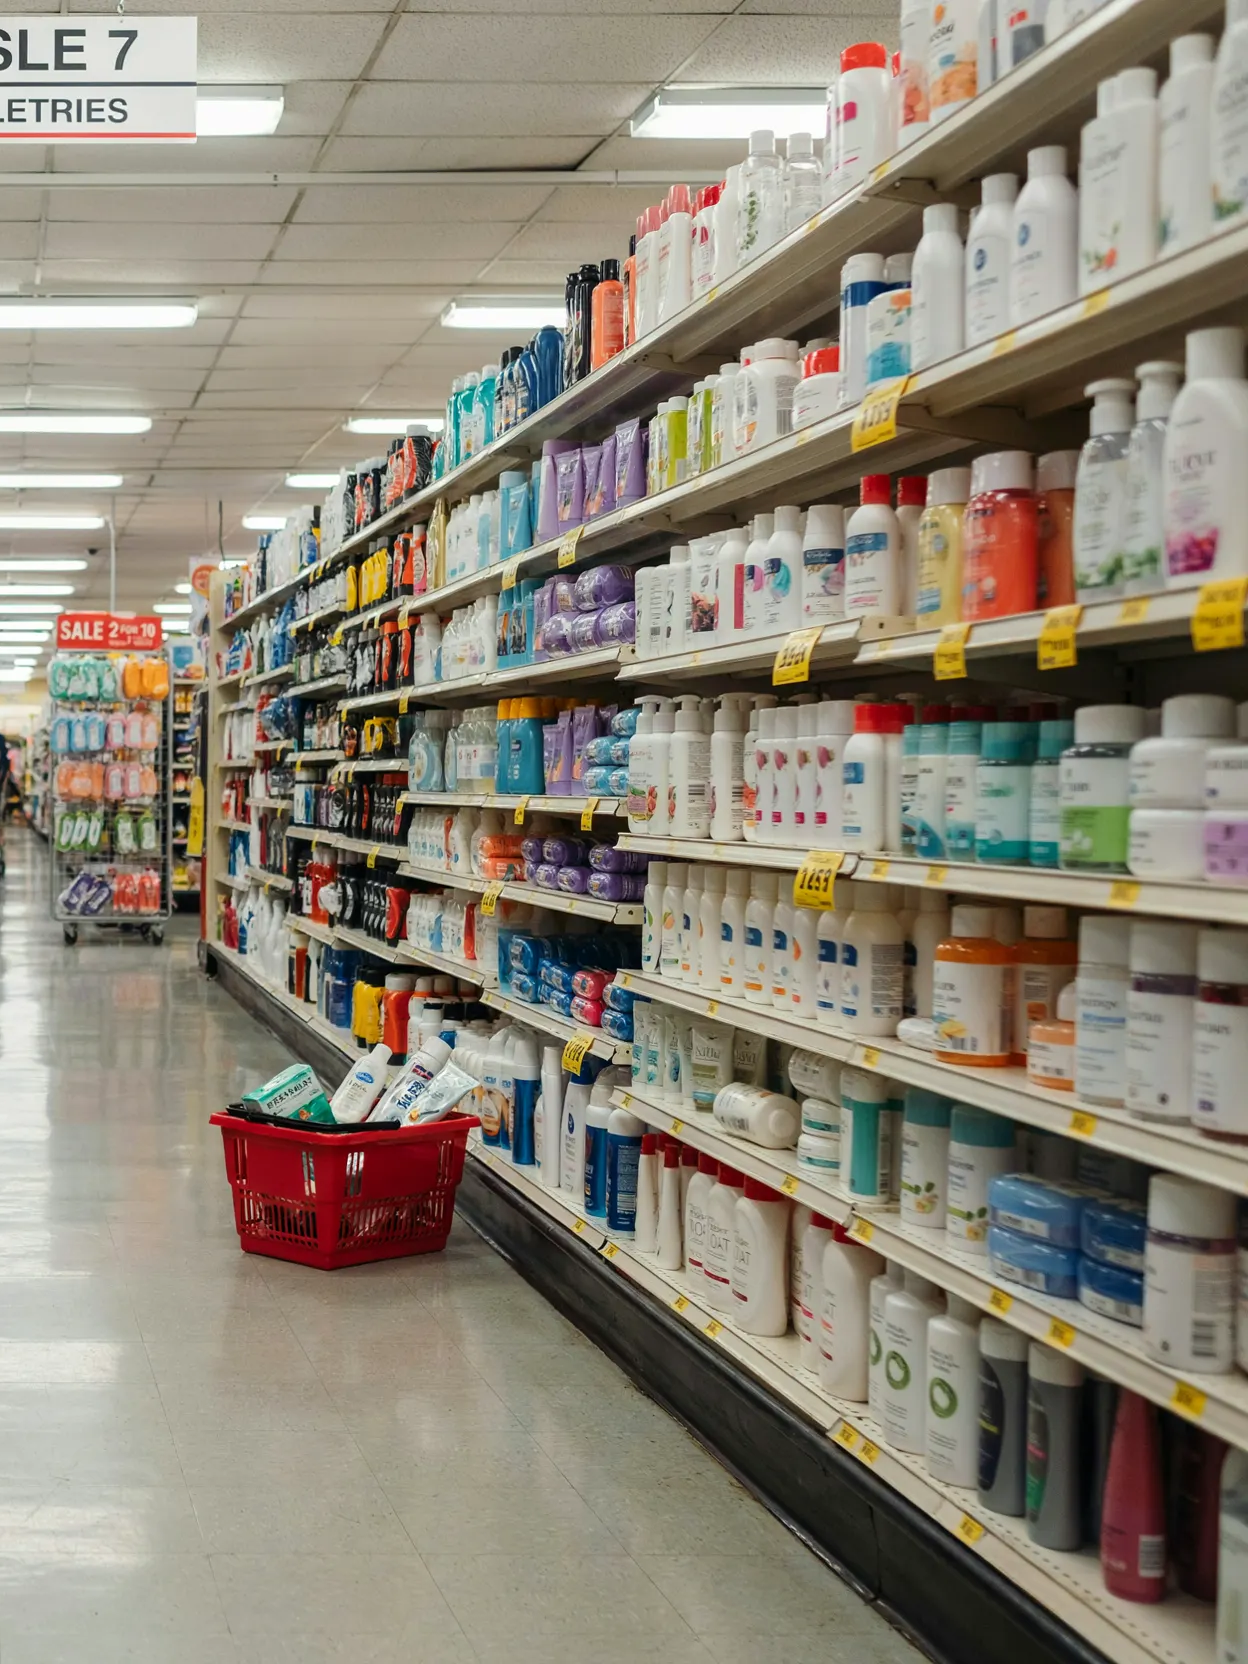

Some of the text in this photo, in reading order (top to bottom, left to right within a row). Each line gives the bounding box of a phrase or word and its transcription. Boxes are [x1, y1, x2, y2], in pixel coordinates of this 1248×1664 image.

[108, 29, 139, 71] 7
[60, 620, 104, 641] SALE
[108, 621, 119, 638] 2
[140, 622, 156, 638] 10
